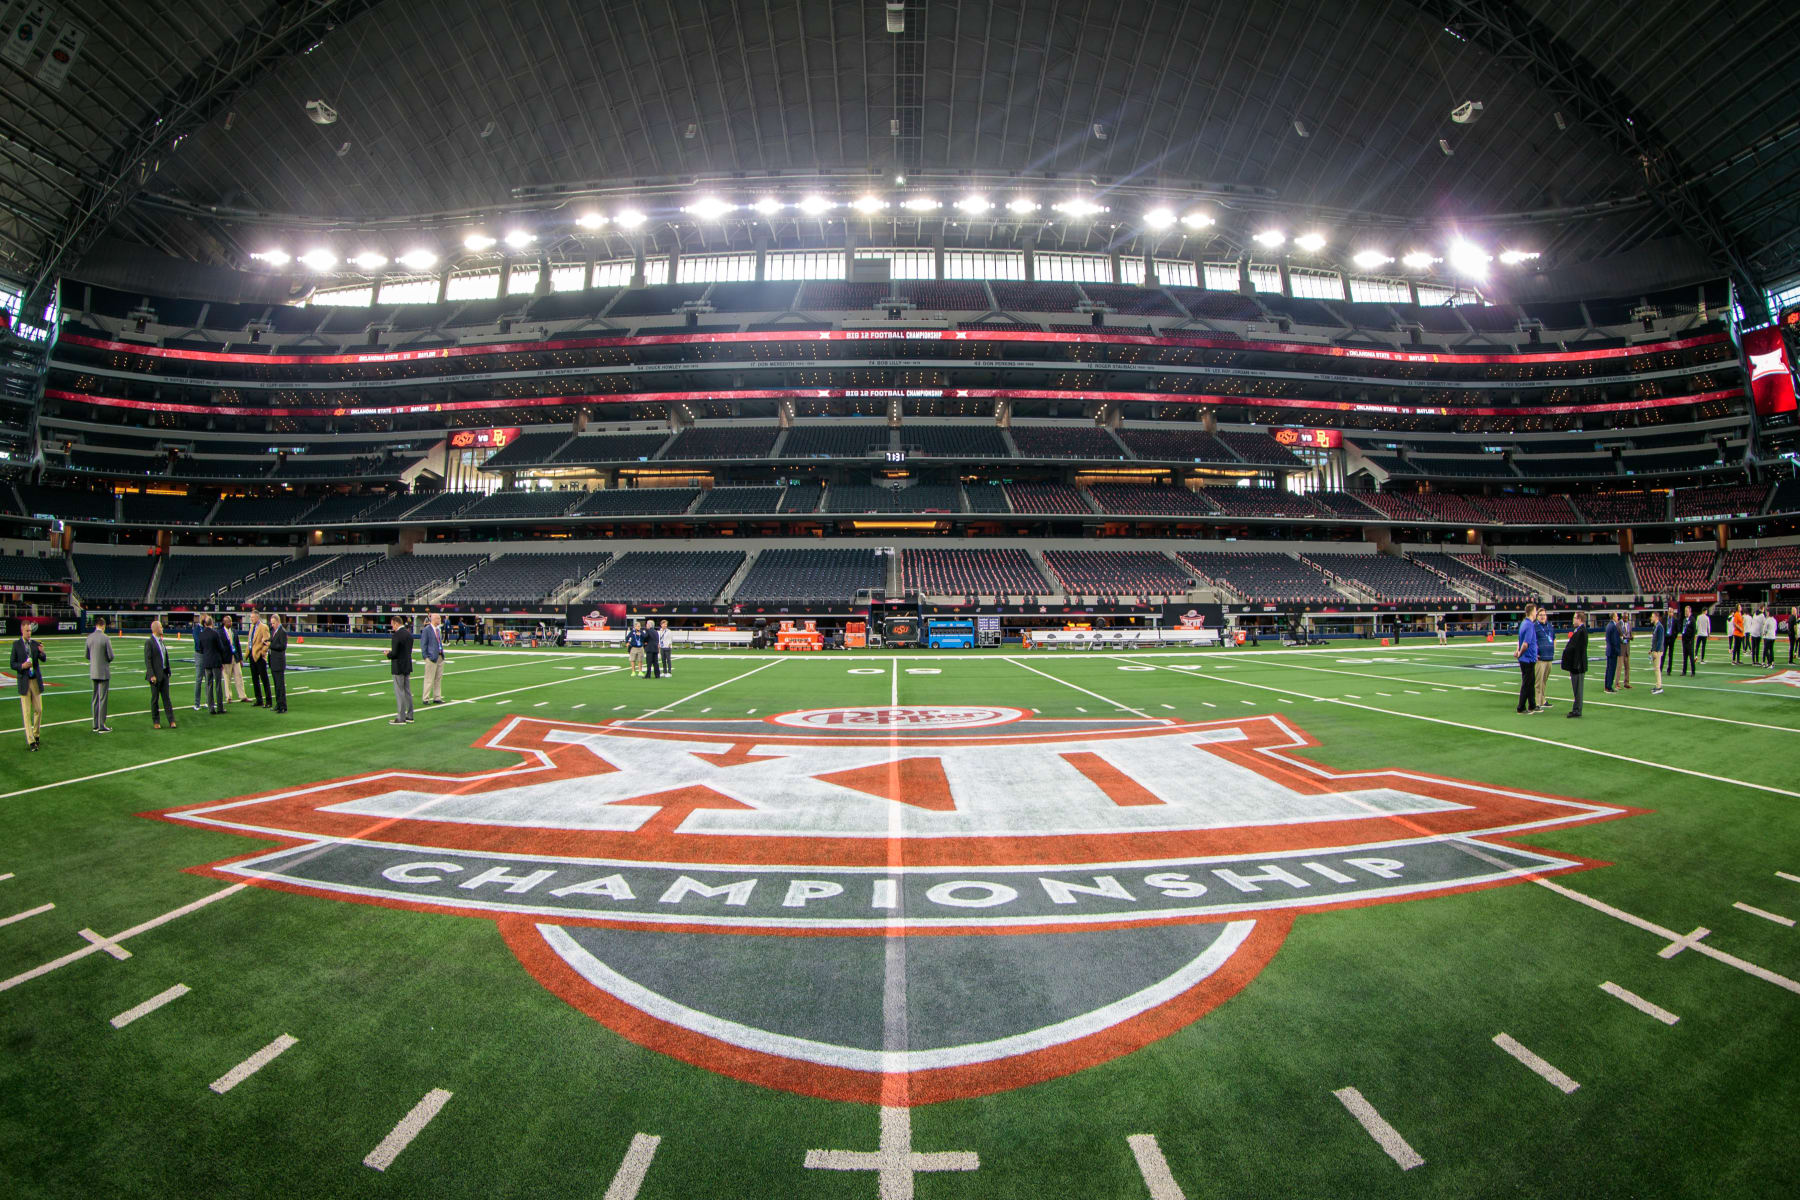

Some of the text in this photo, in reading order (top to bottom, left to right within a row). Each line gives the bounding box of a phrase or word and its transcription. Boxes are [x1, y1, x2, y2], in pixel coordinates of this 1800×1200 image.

[870, 331, 905, 339] FOOTBALL
[906, 331, 942, 339] CHAMPIONSHIP
[870, 389, 905, 397] FOOTBALL
[906, 389, 943, 397] CHAMPIONSHIP
[410, 405, 429, 413] BAYLOR
[452, 432, 475, 447] OSU
[493, 429, 506, 446] BU
[1276, 429, 1298, 445] OSU
[1316, 430, 1329, 448] BU
[58, 622, 78, 631] ESPN
[314, 726, 1476, 838] XII
[381, 856, 1406, 909] CHAMPIONSHIP
